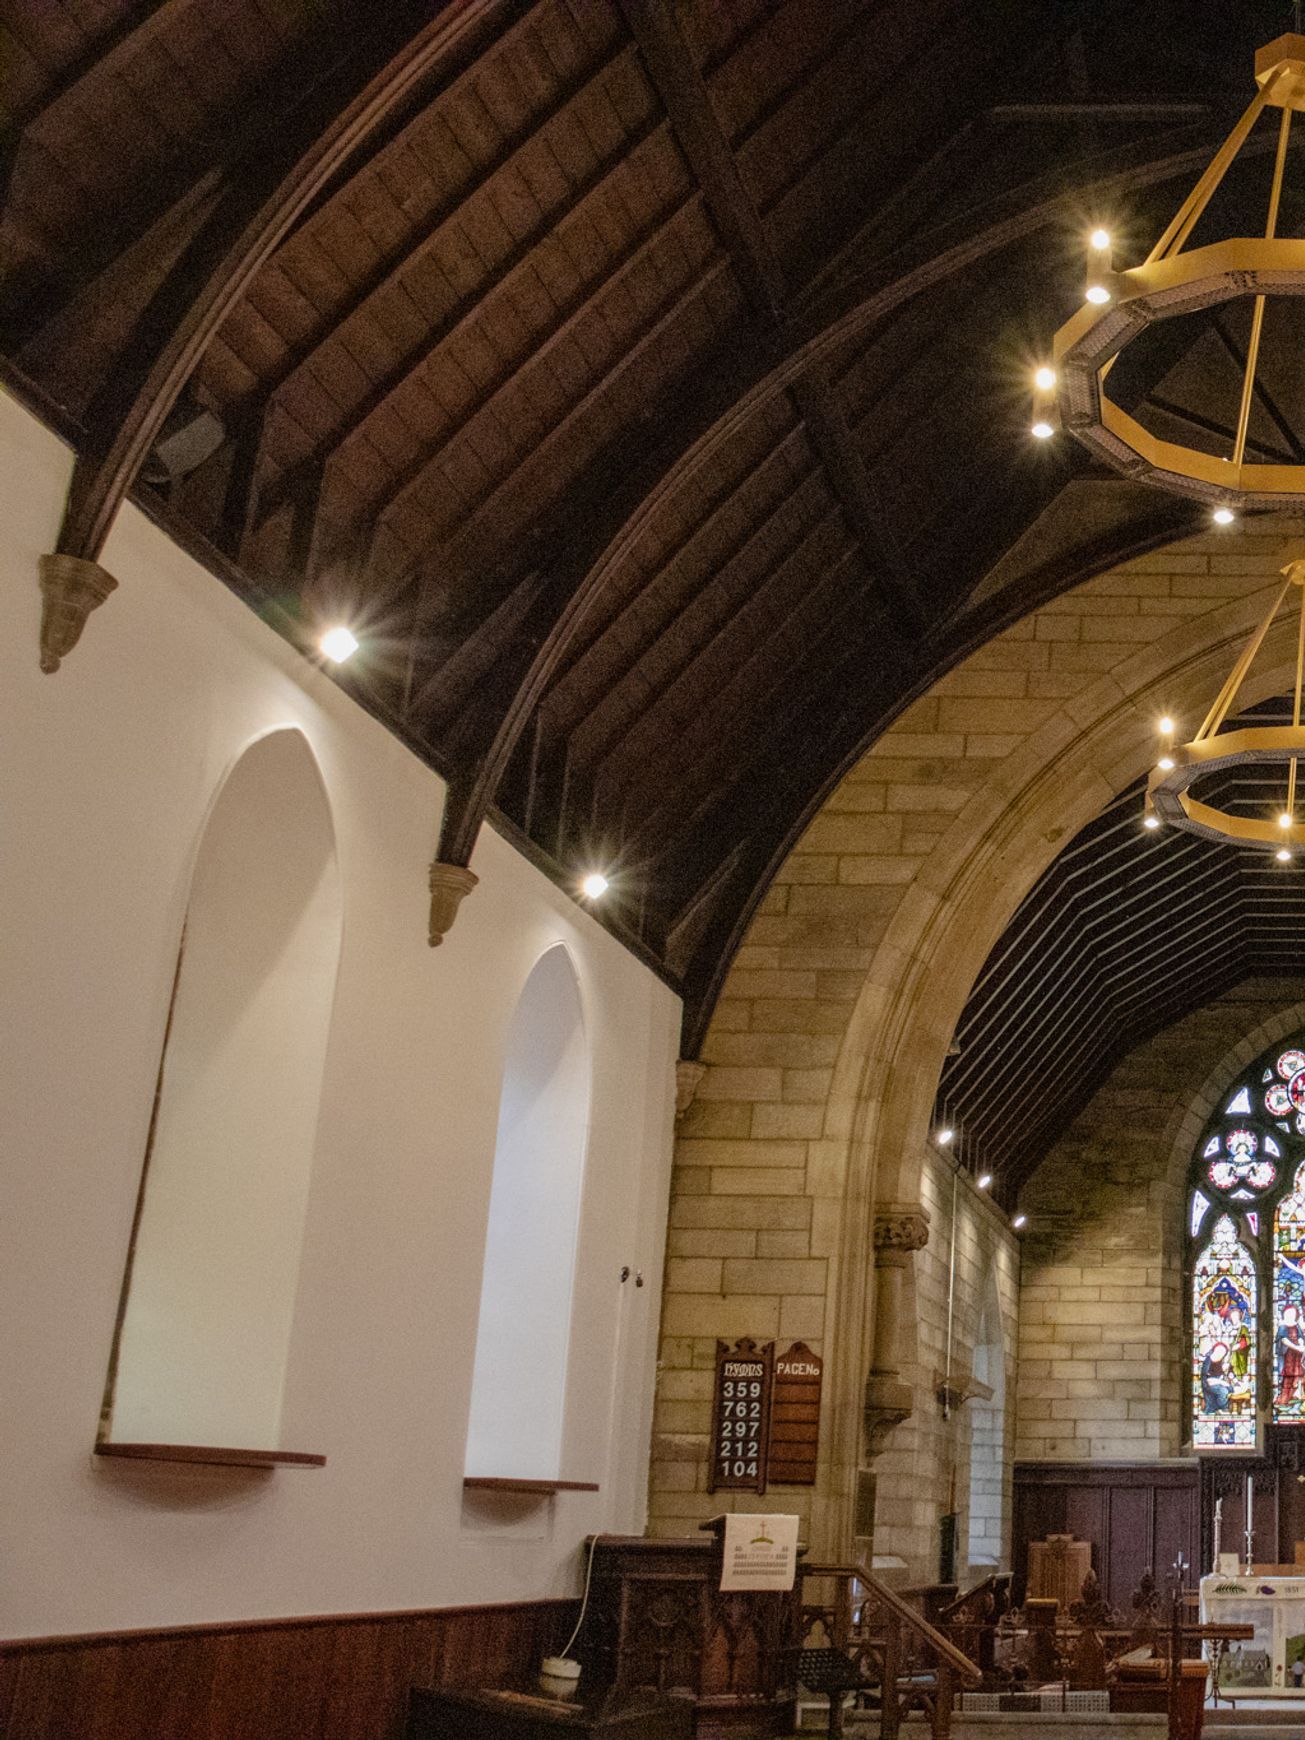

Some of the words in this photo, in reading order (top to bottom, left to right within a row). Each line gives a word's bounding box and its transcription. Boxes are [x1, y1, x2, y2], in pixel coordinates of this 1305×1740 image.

[723, 1381, 761, 1397] 359
[723, 1401, 760, 1418] 762
[721, 1421, 760, 1437] 297
[720, 1441, 759, 1457] 212
[722, 1460, 758, 1477] 104
